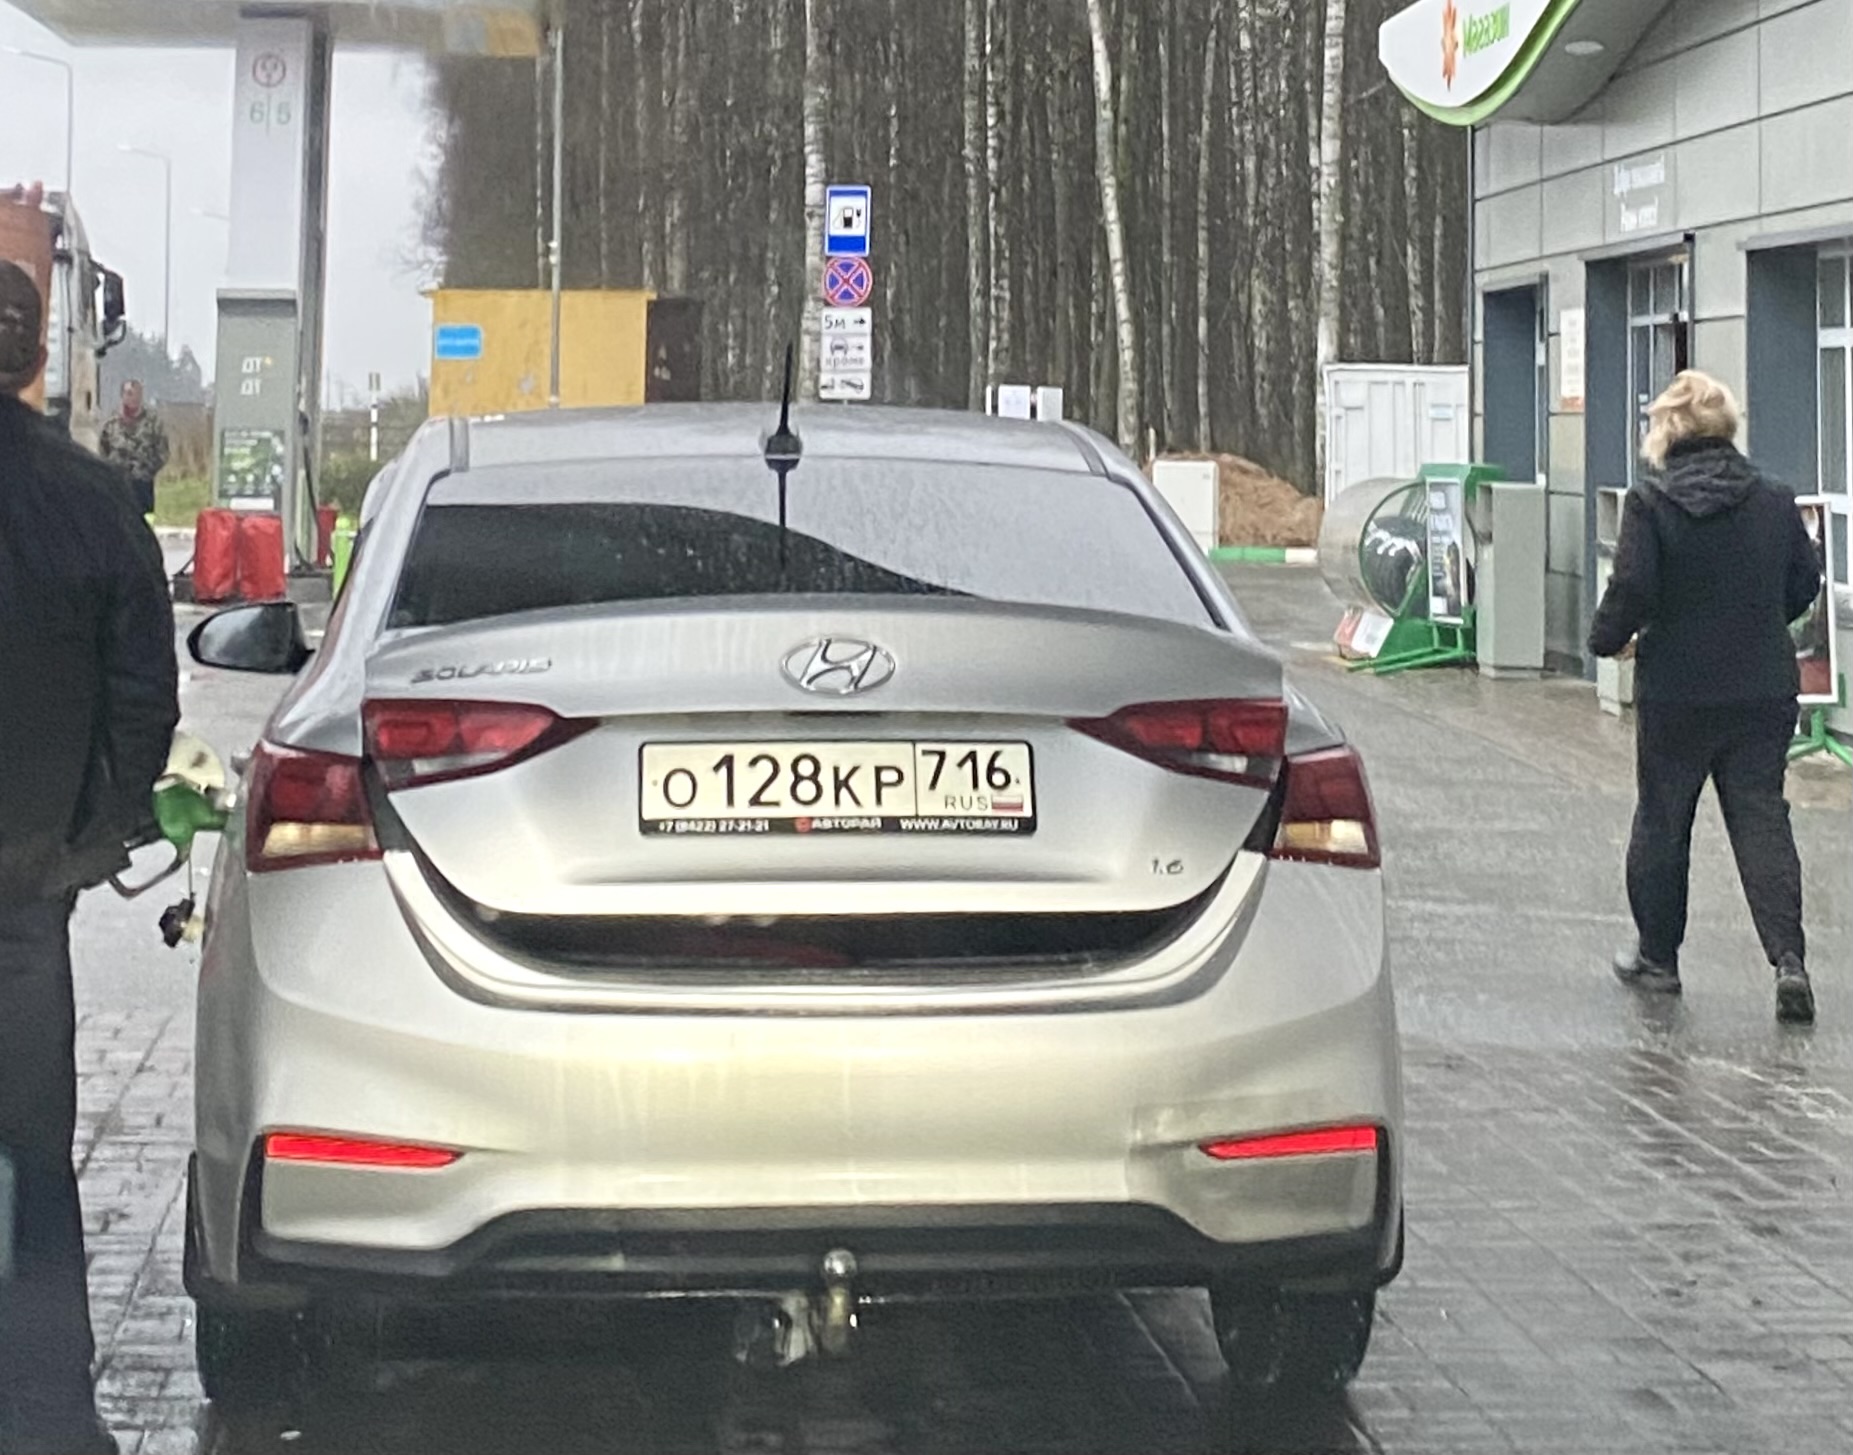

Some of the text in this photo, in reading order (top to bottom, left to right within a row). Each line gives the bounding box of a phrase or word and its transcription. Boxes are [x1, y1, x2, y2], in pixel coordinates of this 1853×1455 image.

[249, 101, 292, 125] 6 5
[922, 750, 1011, 791] 716
[944, 795, 988, 810] RUS
[1151, 858, 1184, 875] 1.6
